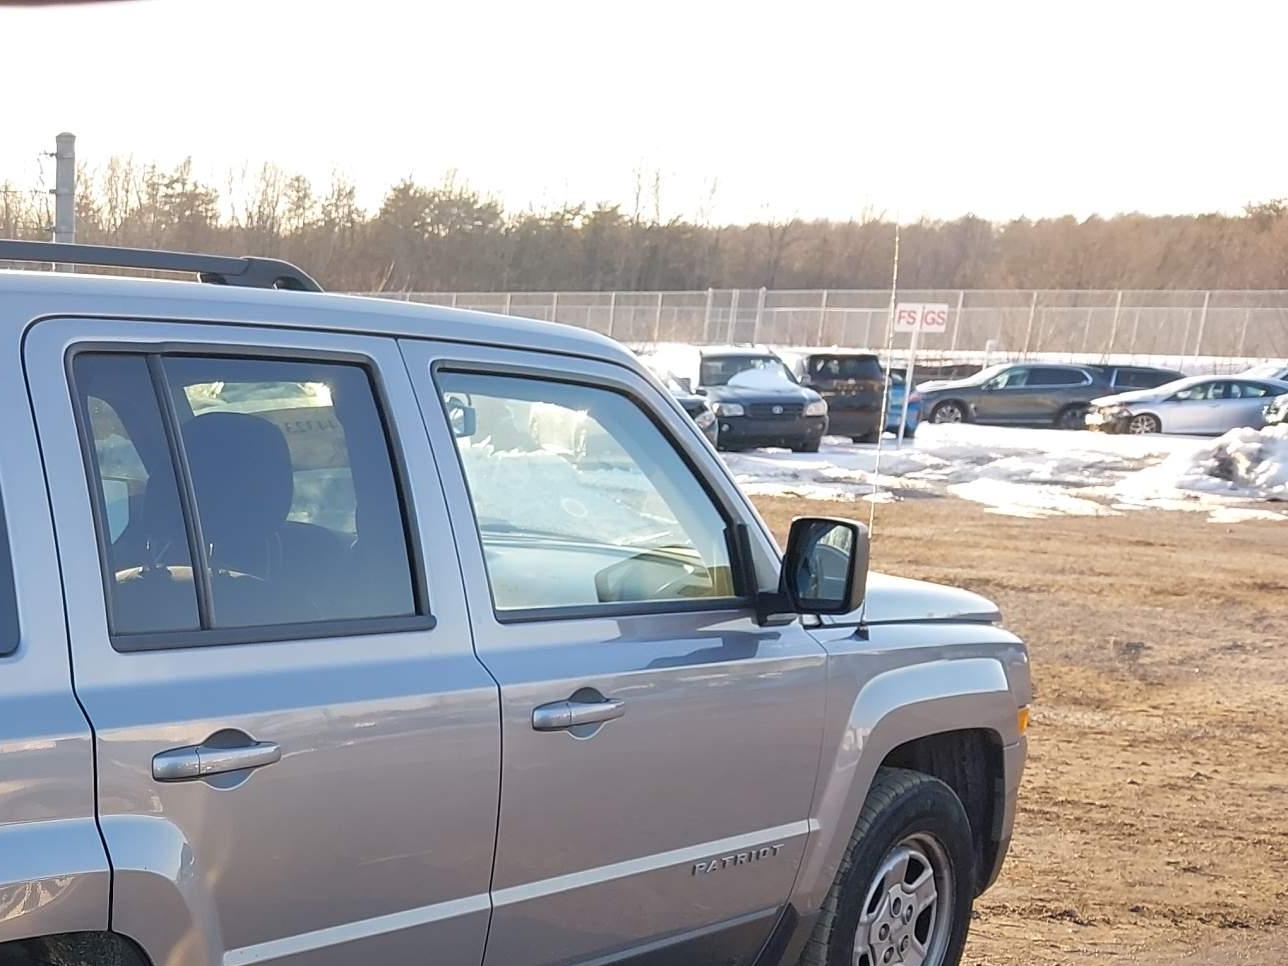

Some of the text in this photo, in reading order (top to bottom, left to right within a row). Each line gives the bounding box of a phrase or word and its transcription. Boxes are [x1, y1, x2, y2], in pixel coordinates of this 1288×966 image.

[897, 310, 946, 326] FS GS
[691, 843, 785, 876] PATRIOT
